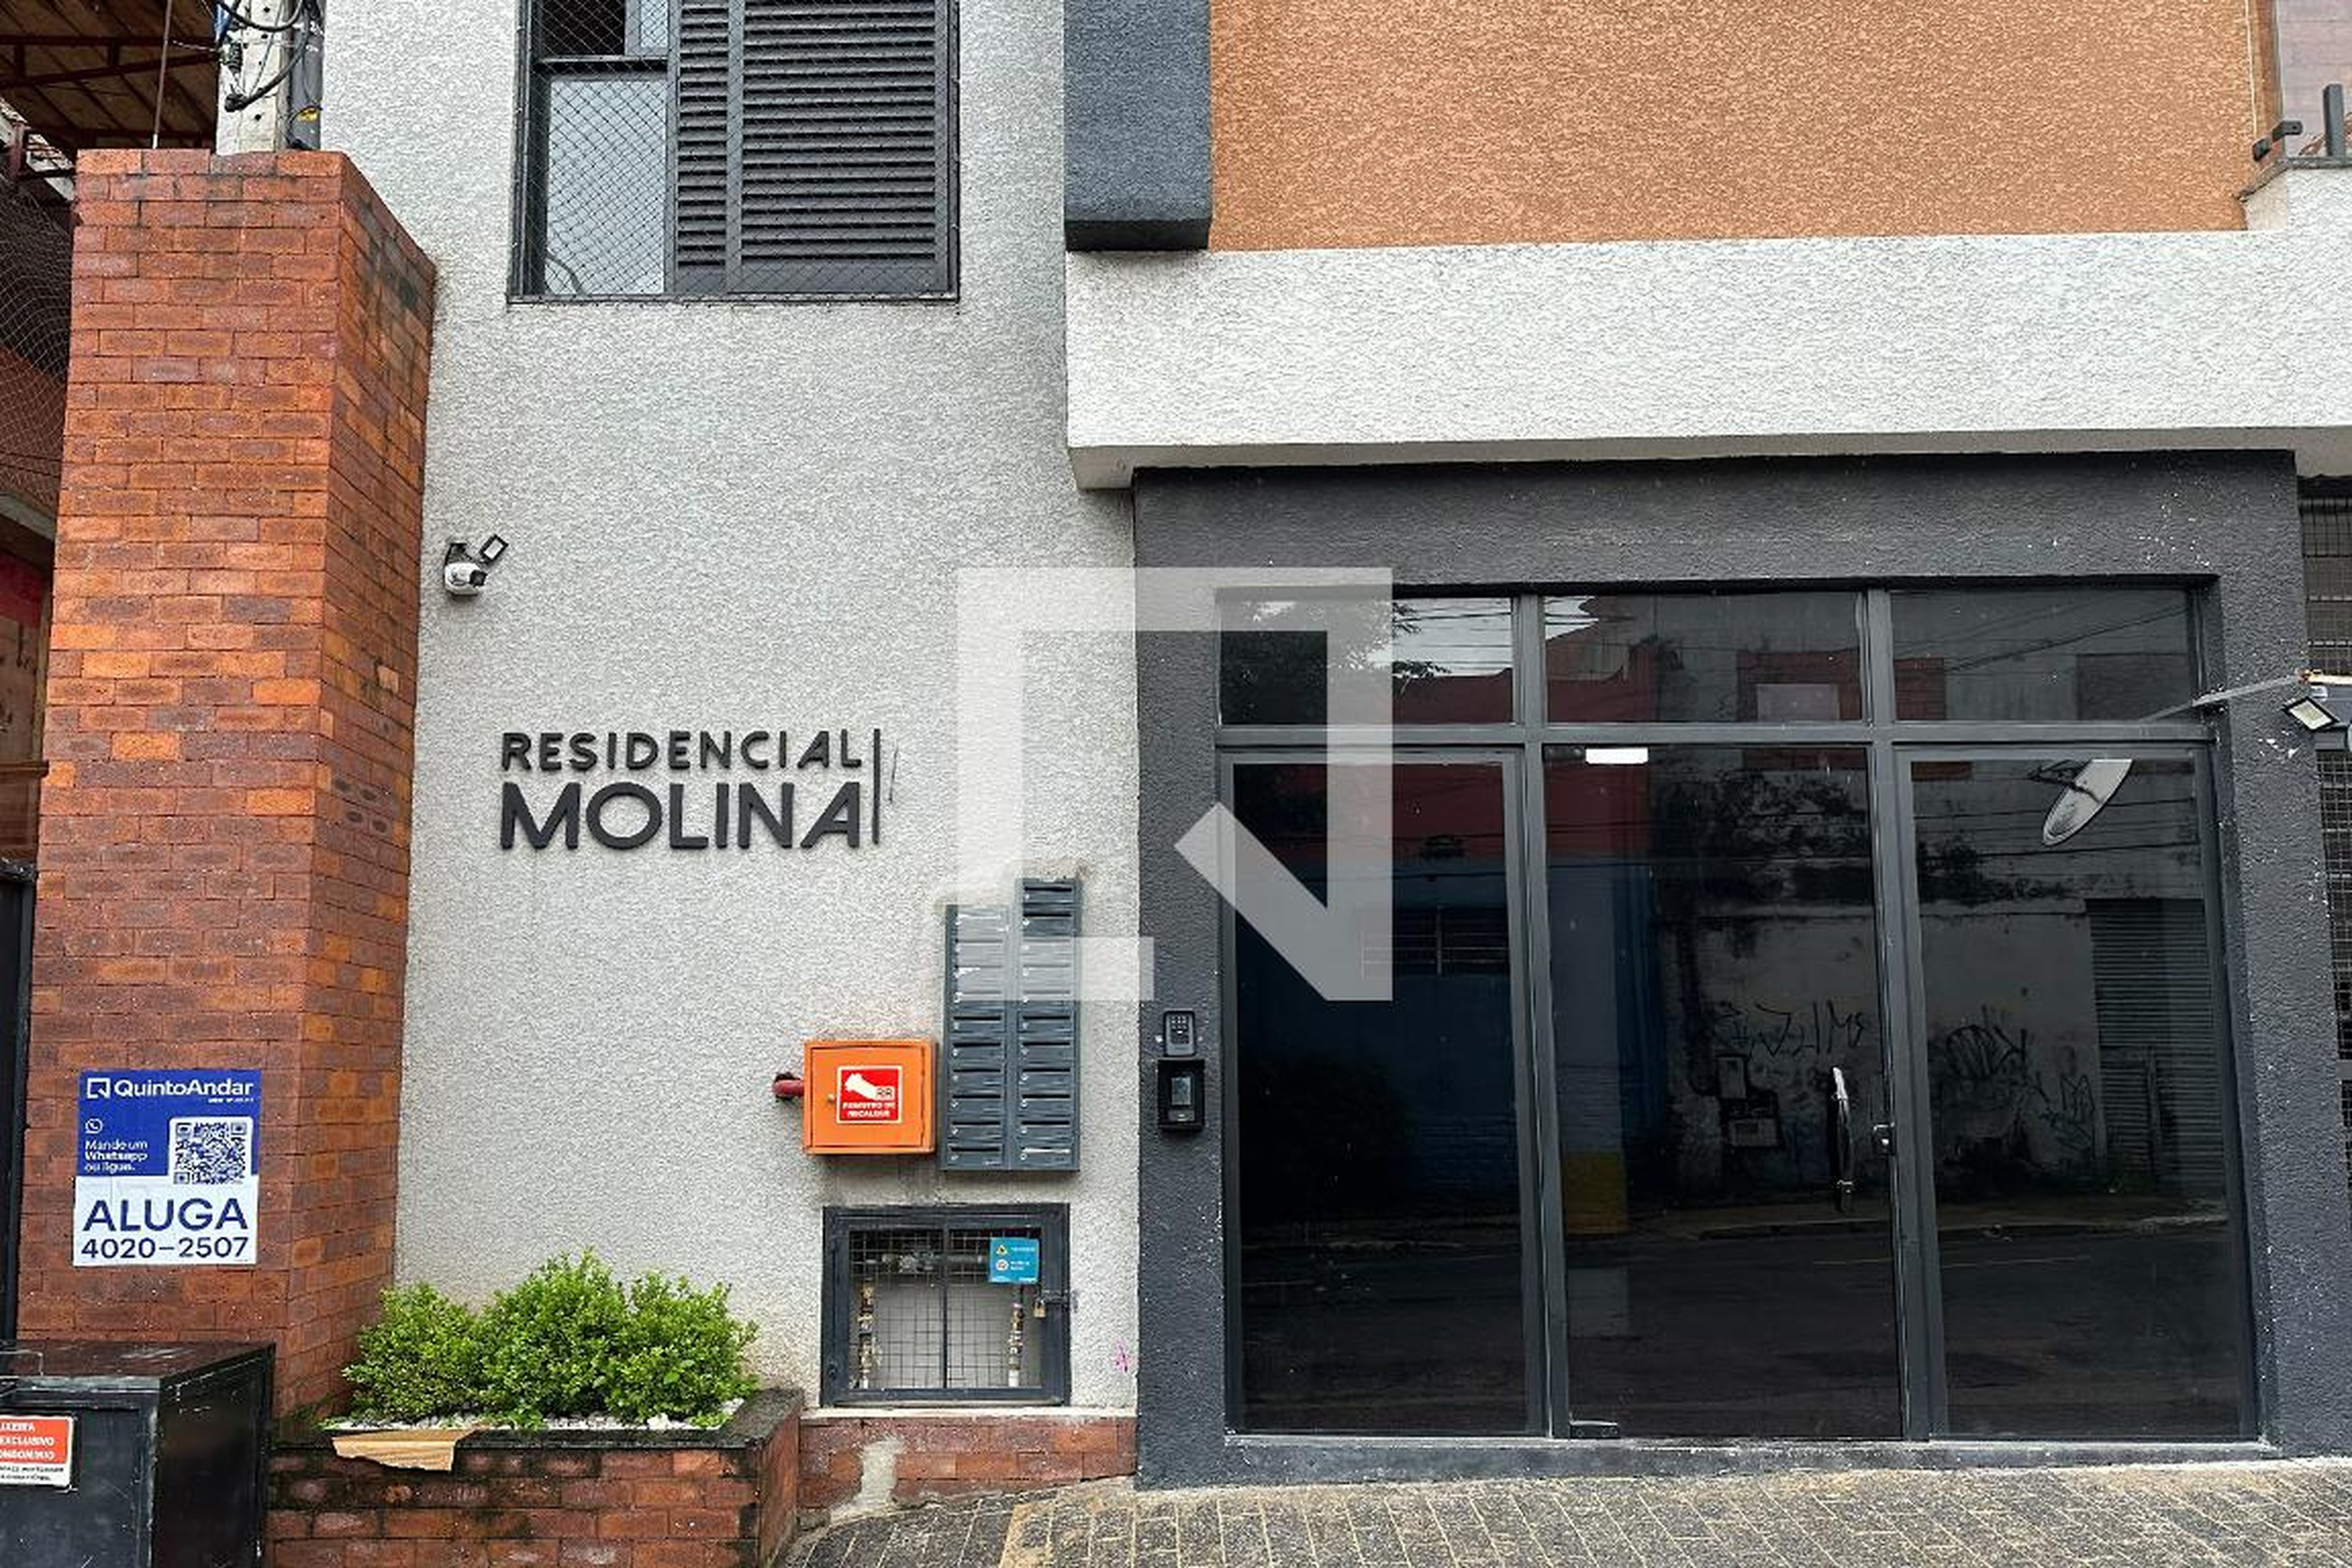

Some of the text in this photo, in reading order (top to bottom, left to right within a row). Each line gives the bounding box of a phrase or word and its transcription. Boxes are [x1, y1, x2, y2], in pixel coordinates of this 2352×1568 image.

[501, 729, 862, 771] RESIDENCIAL
[499, 782, 861, 850] MOLINA
[114, 1078, 254, 1097] QuintoAndar
[85, 1139, 148, 1150] Mande um
[82, 1198, 248, 1232] ALUGA
[81, 1237, 249, 1259] 4020-2507
